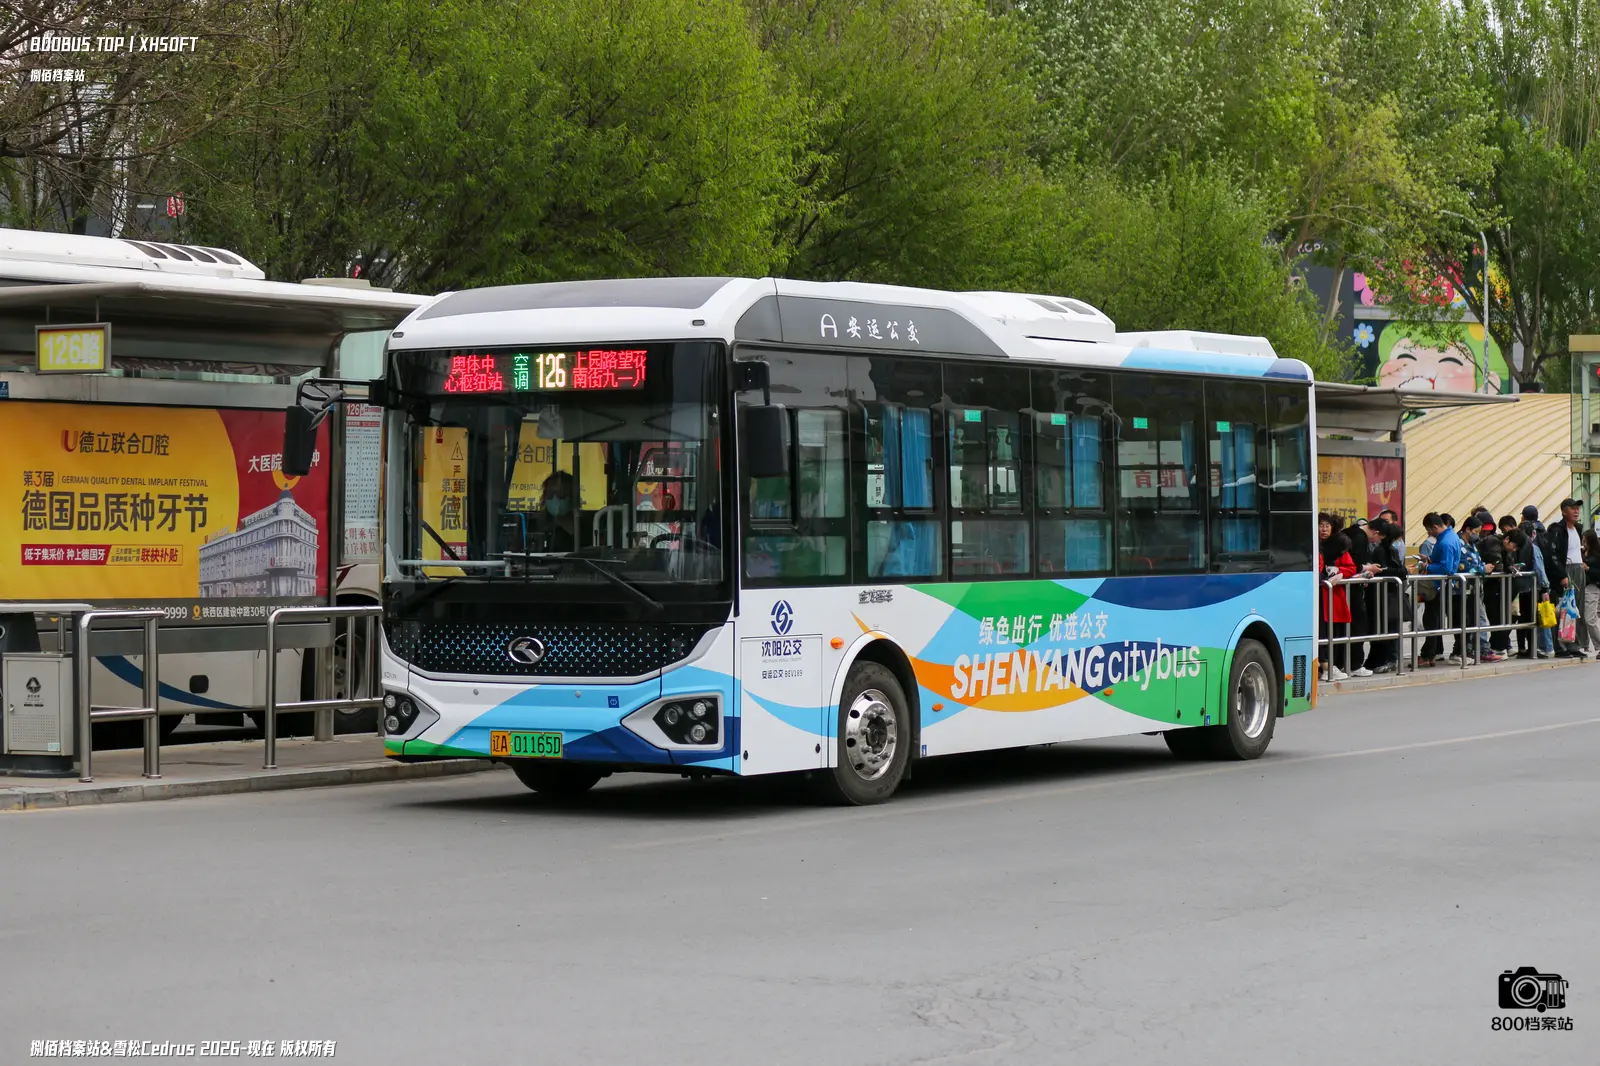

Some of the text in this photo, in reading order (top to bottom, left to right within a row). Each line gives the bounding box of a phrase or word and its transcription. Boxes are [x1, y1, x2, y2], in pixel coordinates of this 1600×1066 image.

[846, 316, 920, 344] 安运公交
[44, 332, 100, 366] 126路
[451, 355, 495, 374] 奥体中
[513, 353, 529, 390] 空调
[535, 353, 566, 388] 126
[444, 372, 504, 392] 心枢纽站
[346, 403, 360, 416] 126
[79, 431, 169, 456] 德立联合口腔
[248, 452, 283, 473] 大医院
[23, 471, 54, 487] 第3届
[61, 475, 208, 487] GERMAN QUALITY DENTAL IMPLANT FESTIVAL
[21, 489, 209, 533] 德国品质种牙节
[24, 547, 105, 561] 低于集采价 种上德国牙
[979, 611, 1109, 646] 绿色出行 优选公交
[761, 639, 802, 657] 沈阳公交
[950, 637, 1201, 700] SHENYANG citybus
[493, 734, 561, 754] 辽A 01165D
